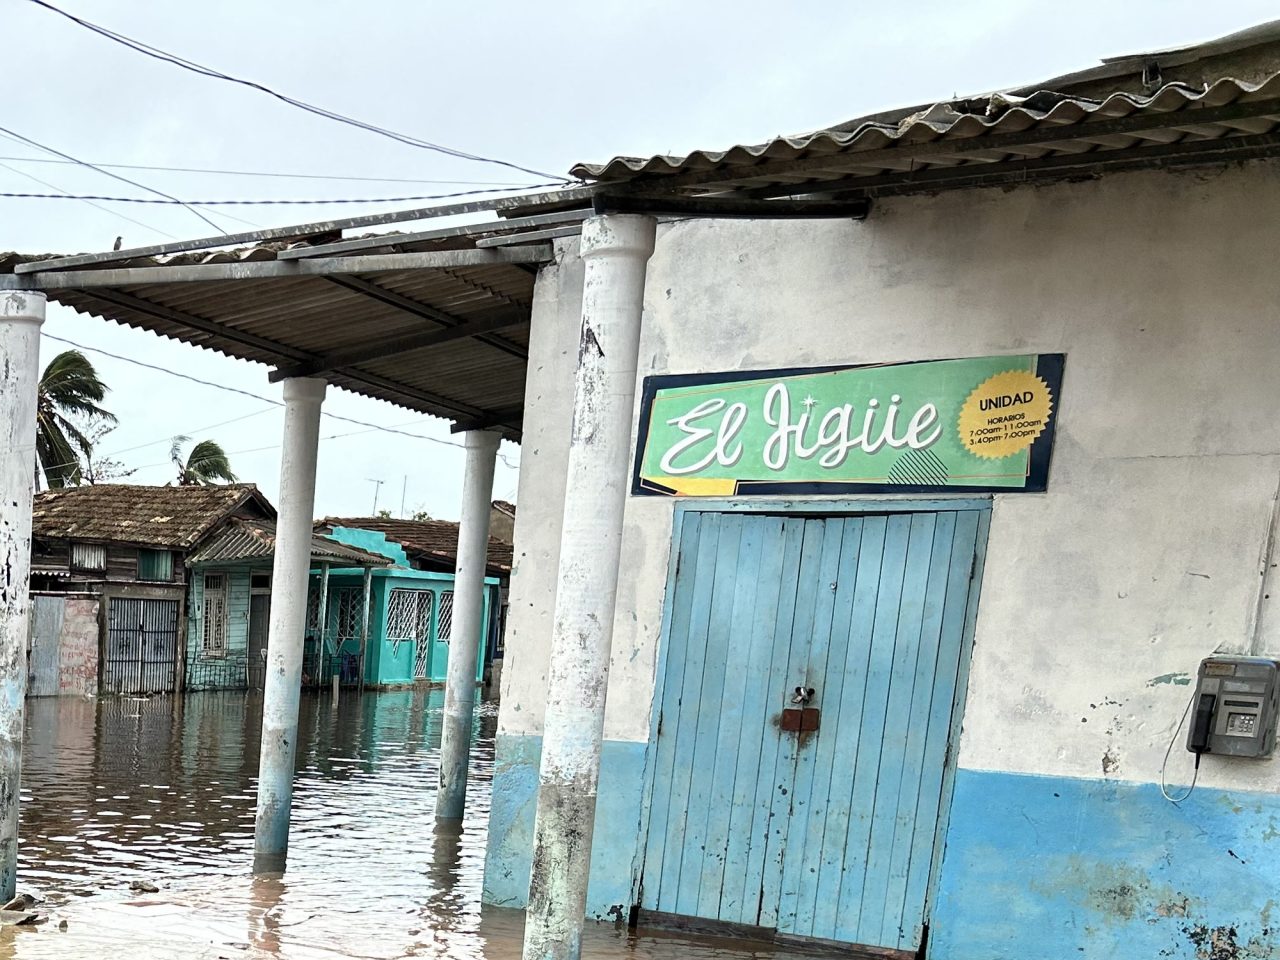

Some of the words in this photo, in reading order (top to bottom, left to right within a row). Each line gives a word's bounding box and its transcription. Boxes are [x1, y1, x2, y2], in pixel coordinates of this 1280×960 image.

[980, 391, 1034, 411] UNIDAD
[659, 397, 747, 474] El
[762, 383, 941, 468] Jigüe
[987, 413, 1026, 425] HORARIOS
